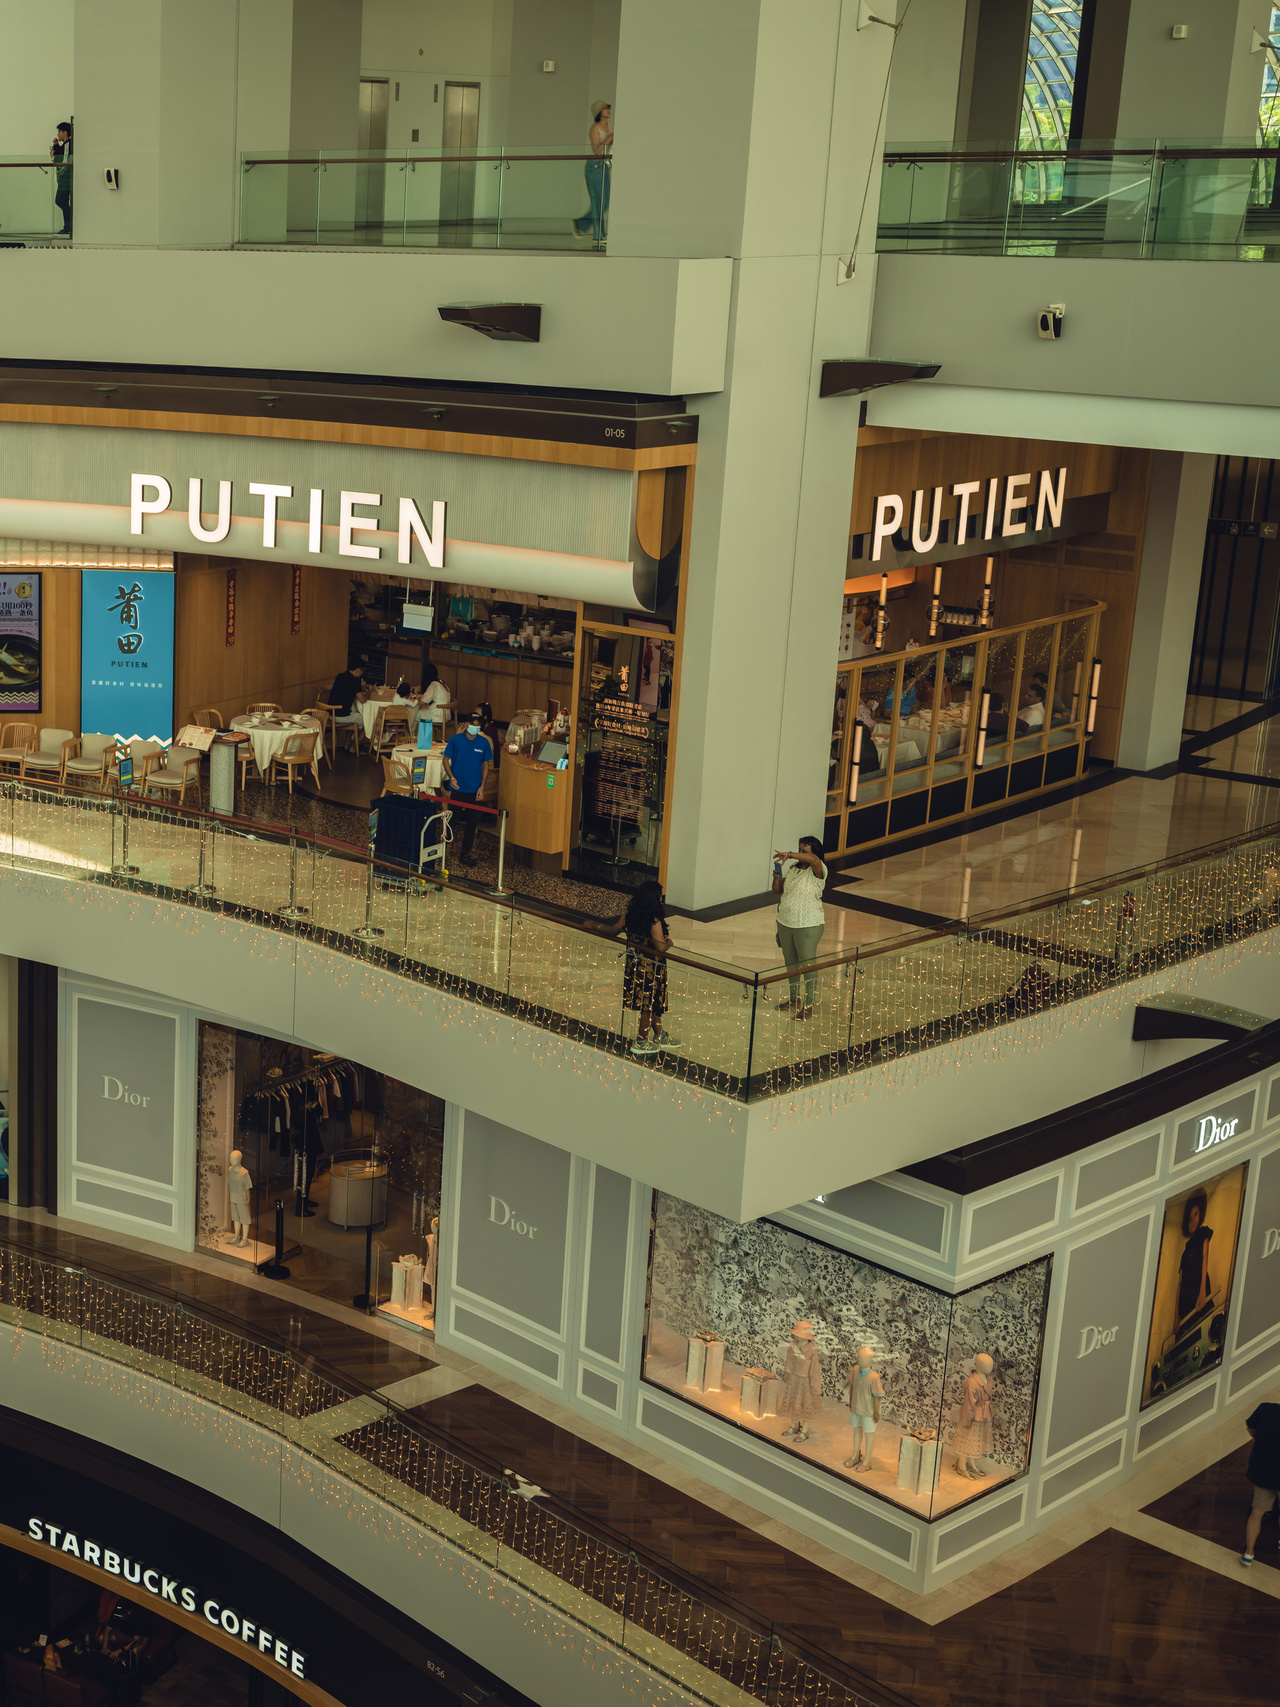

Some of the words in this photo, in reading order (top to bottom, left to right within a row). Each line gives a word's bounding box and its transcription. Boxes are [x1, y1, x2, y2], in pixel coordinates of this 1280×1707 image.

[604, 427, 626, 439] 01-05
[130, 473, 447, 569] PUTIEN
[871, 467, 1068, 562] PUTIEN
[107, 581, 145, 655] 莆田
[110, 660, 148, 669] PUTIEN
[101, 1074, 151, 1108] Dior
[1194, 1114, 1239, 1153] Dior
[488, 1195, 538, 1240] Dior
[1077, 1323, 1120, 1360] Dior
[28, 1517, 196, 1612] STARBUCKS
[203, 1600, 306, 1680] COFFEE
[426, 1659, 446, 1679] B2-56
